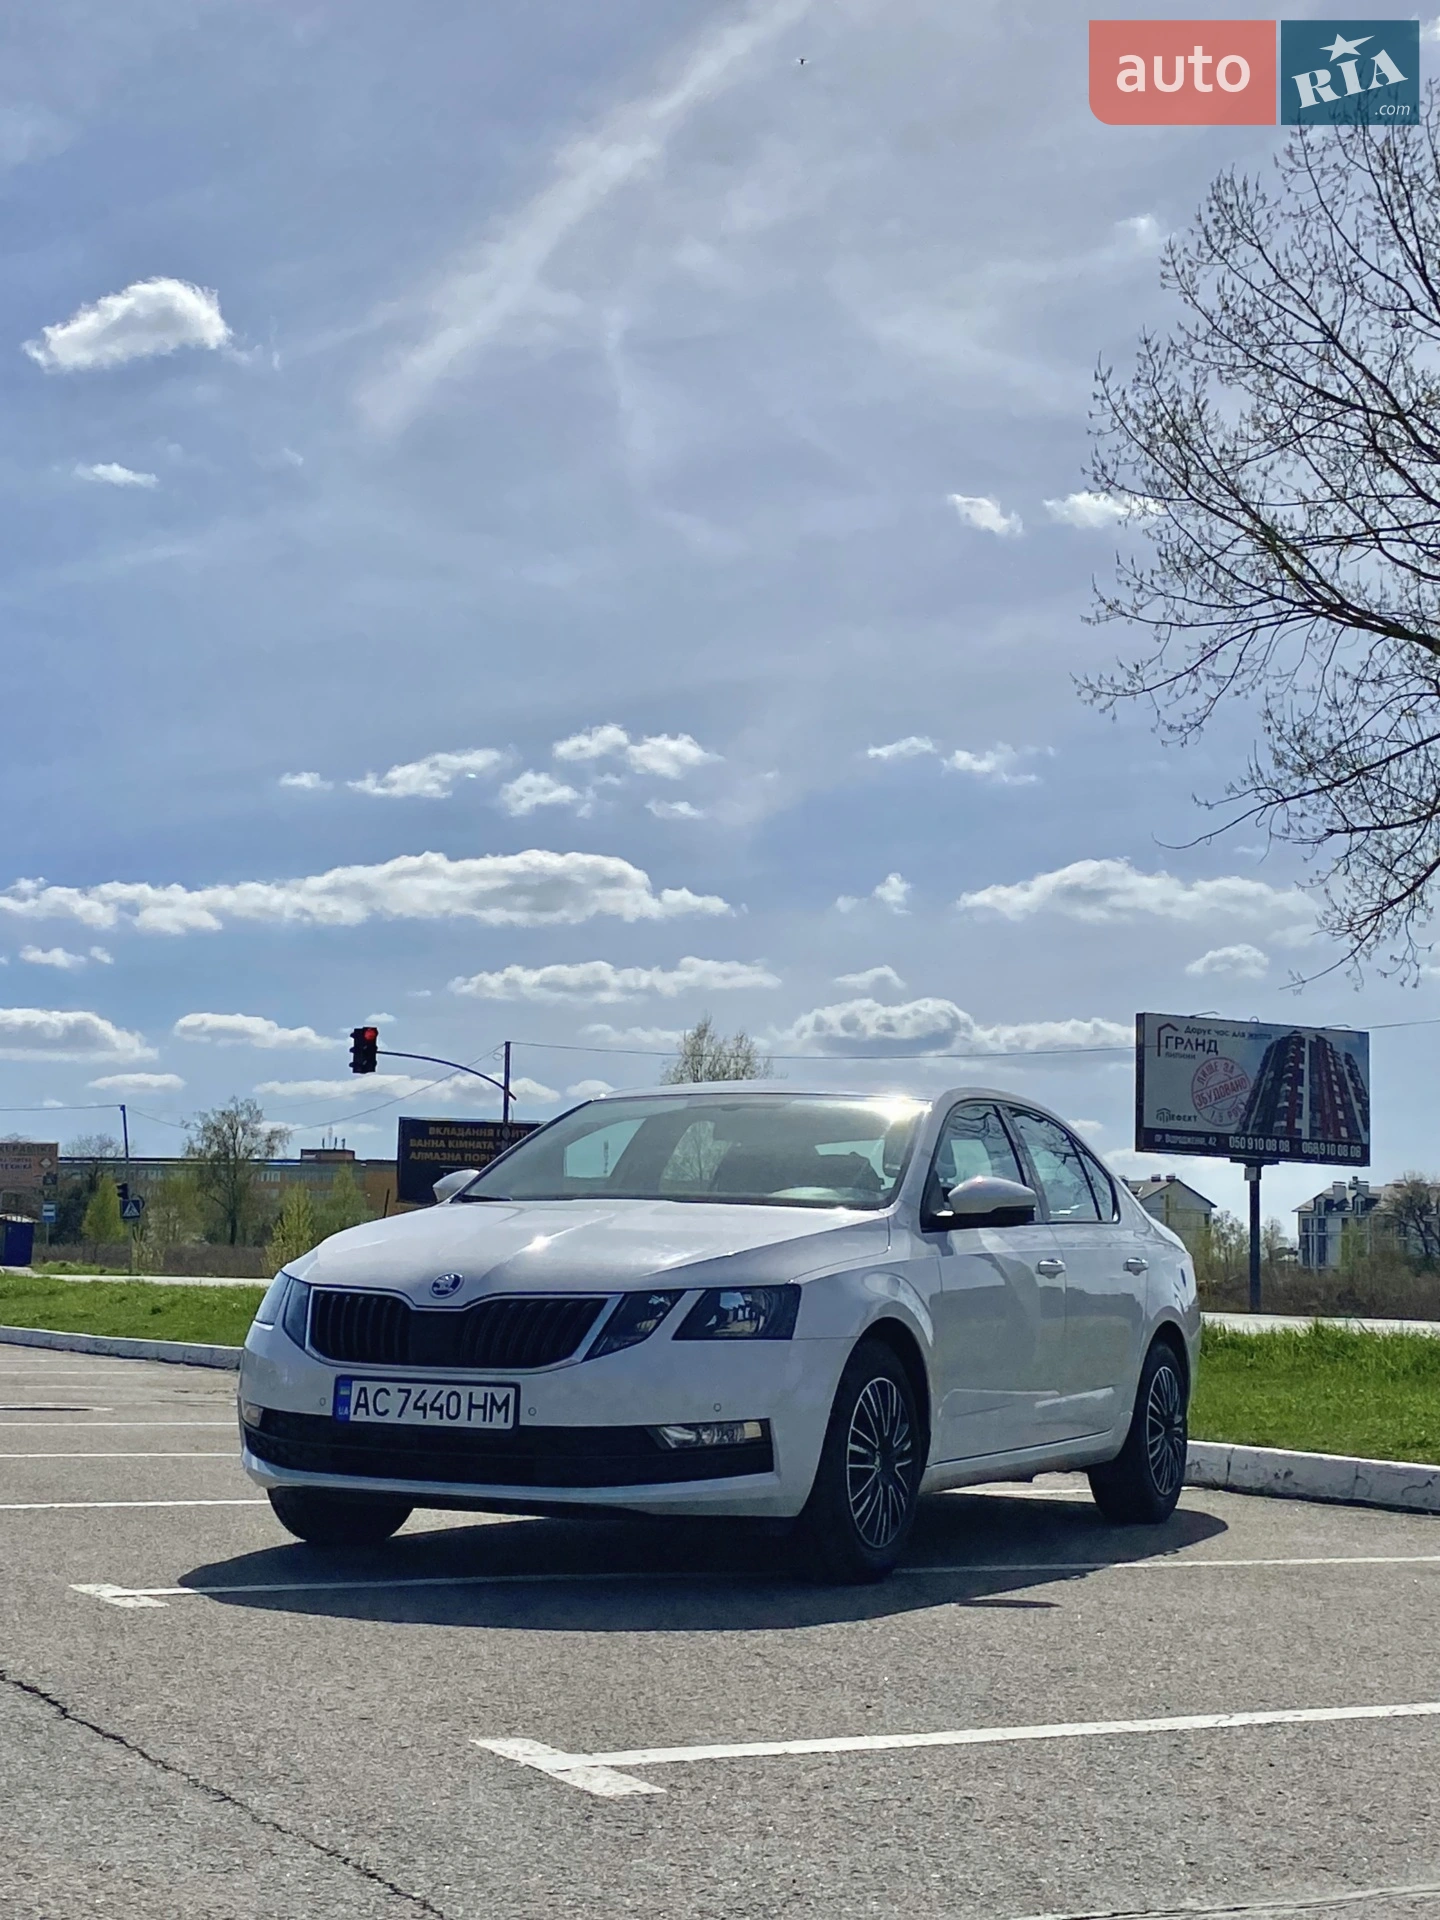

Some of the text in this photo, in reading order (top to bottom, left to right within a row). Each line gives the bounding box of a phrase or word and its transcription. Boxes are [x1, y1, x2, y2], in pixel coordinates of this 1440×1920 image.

[1165, 1035, 1218, 1055] ГРАНД
[1195, 1077, 1248, 1108] ЗБУДОВАНО
[428, 1127, 494, 1137] ВКЛАДАННЯ
[410, 1138, 446, 1148] ВАННА
[448, 1140, 495, 1150] КІМНАТА
[1229, 1136, 1246, 1149] 050
[1247, 1137, 1264, 1151] 910
[410, 1152, 462, 1162] АЛМАЗНА
[338, 1405, 348, 1415] UA
